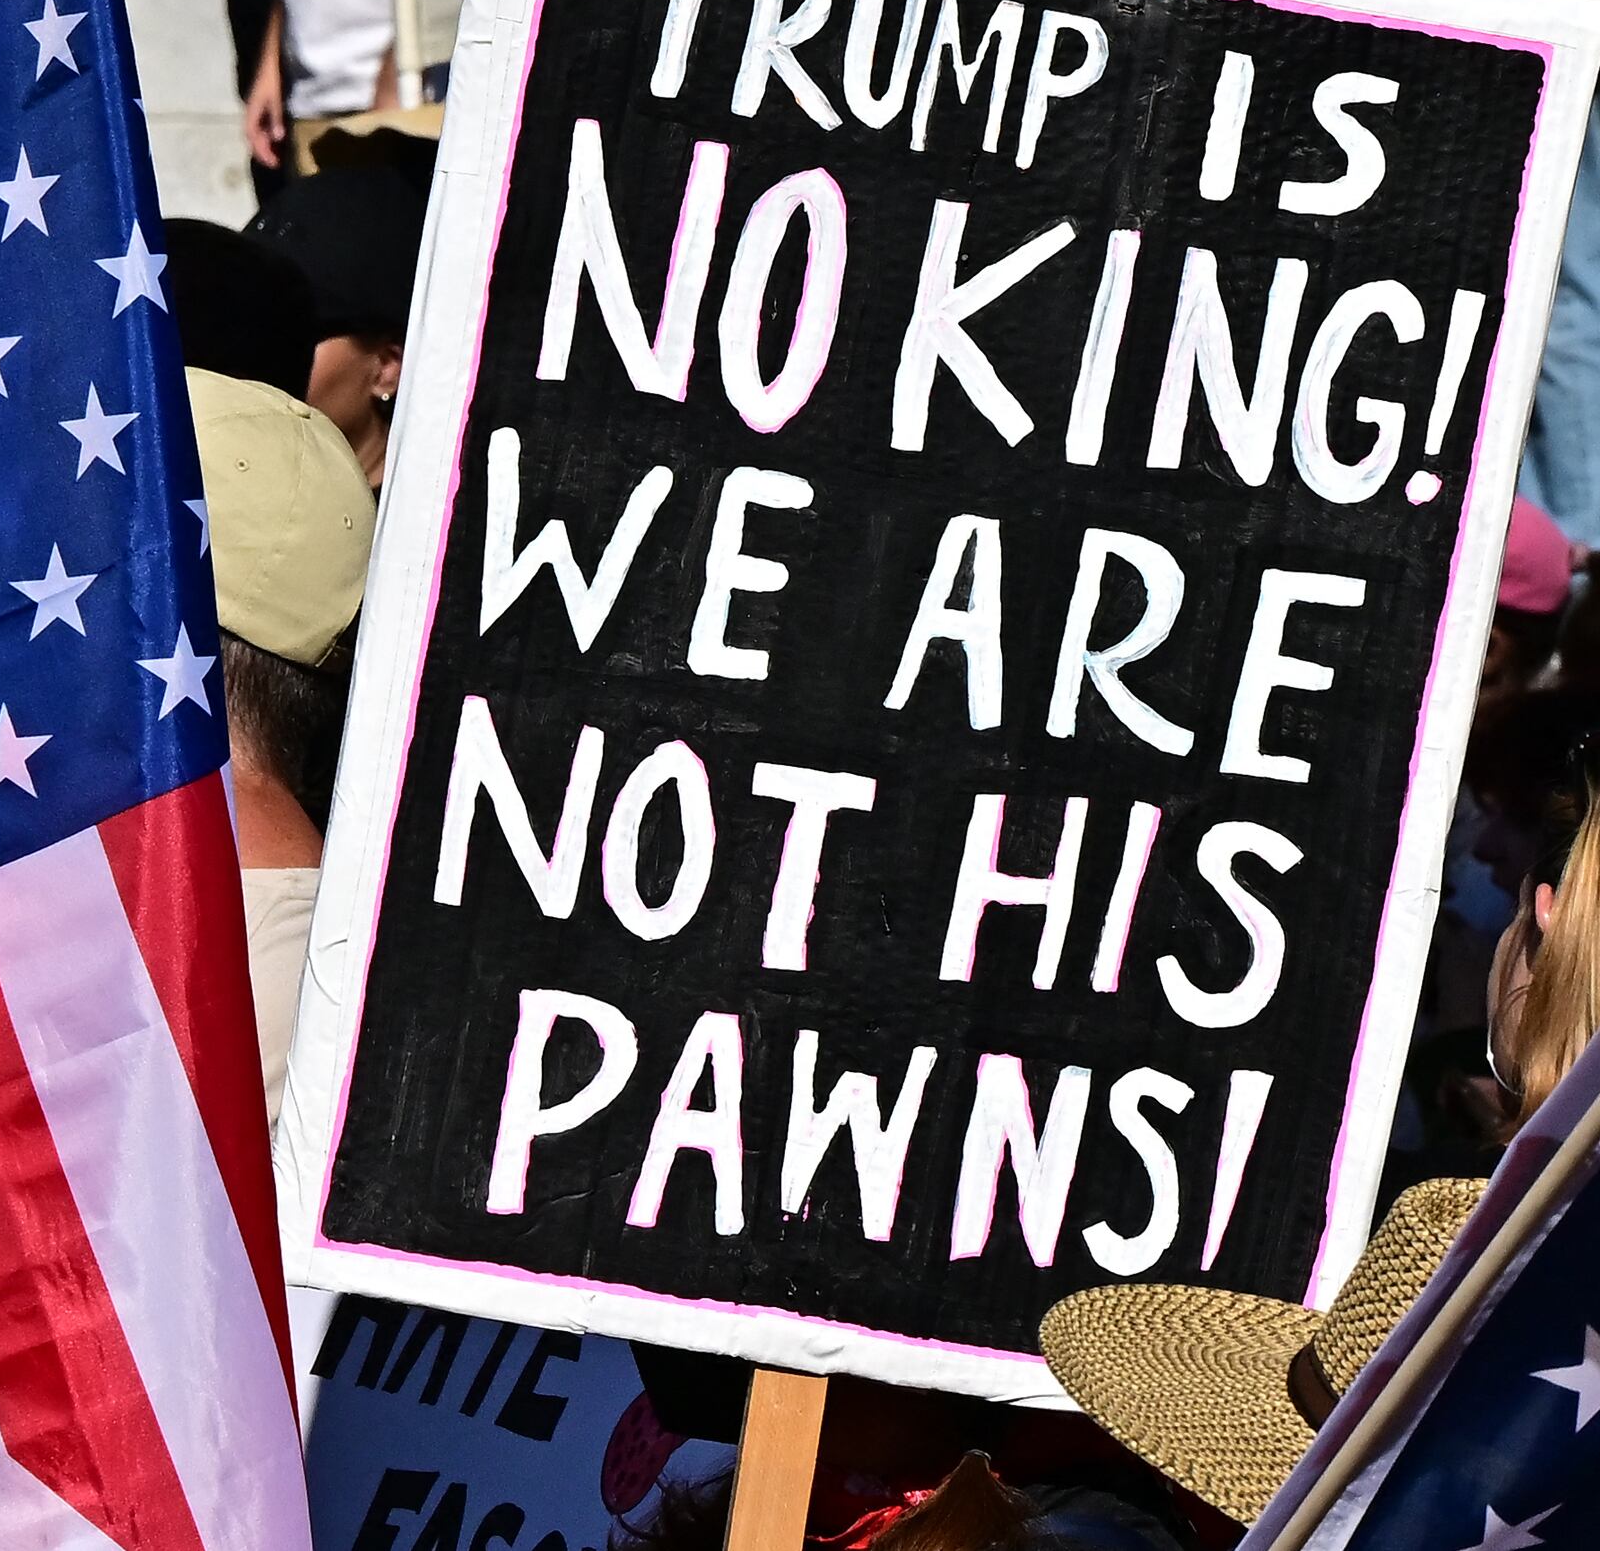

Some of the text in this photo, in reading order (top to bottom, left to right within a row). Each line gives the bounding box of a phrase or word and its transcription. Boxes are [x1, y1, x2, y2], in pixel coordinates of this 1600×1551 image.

[1199, 50, 1399, 218] IS
[535, 119, 1488, 507] NO KING!
[479, 428, 1368, 785] WE ARE
[433, 694, 1306, 1030] NOT HIS
[484, 987, 1275, 1276] PAWNS!
